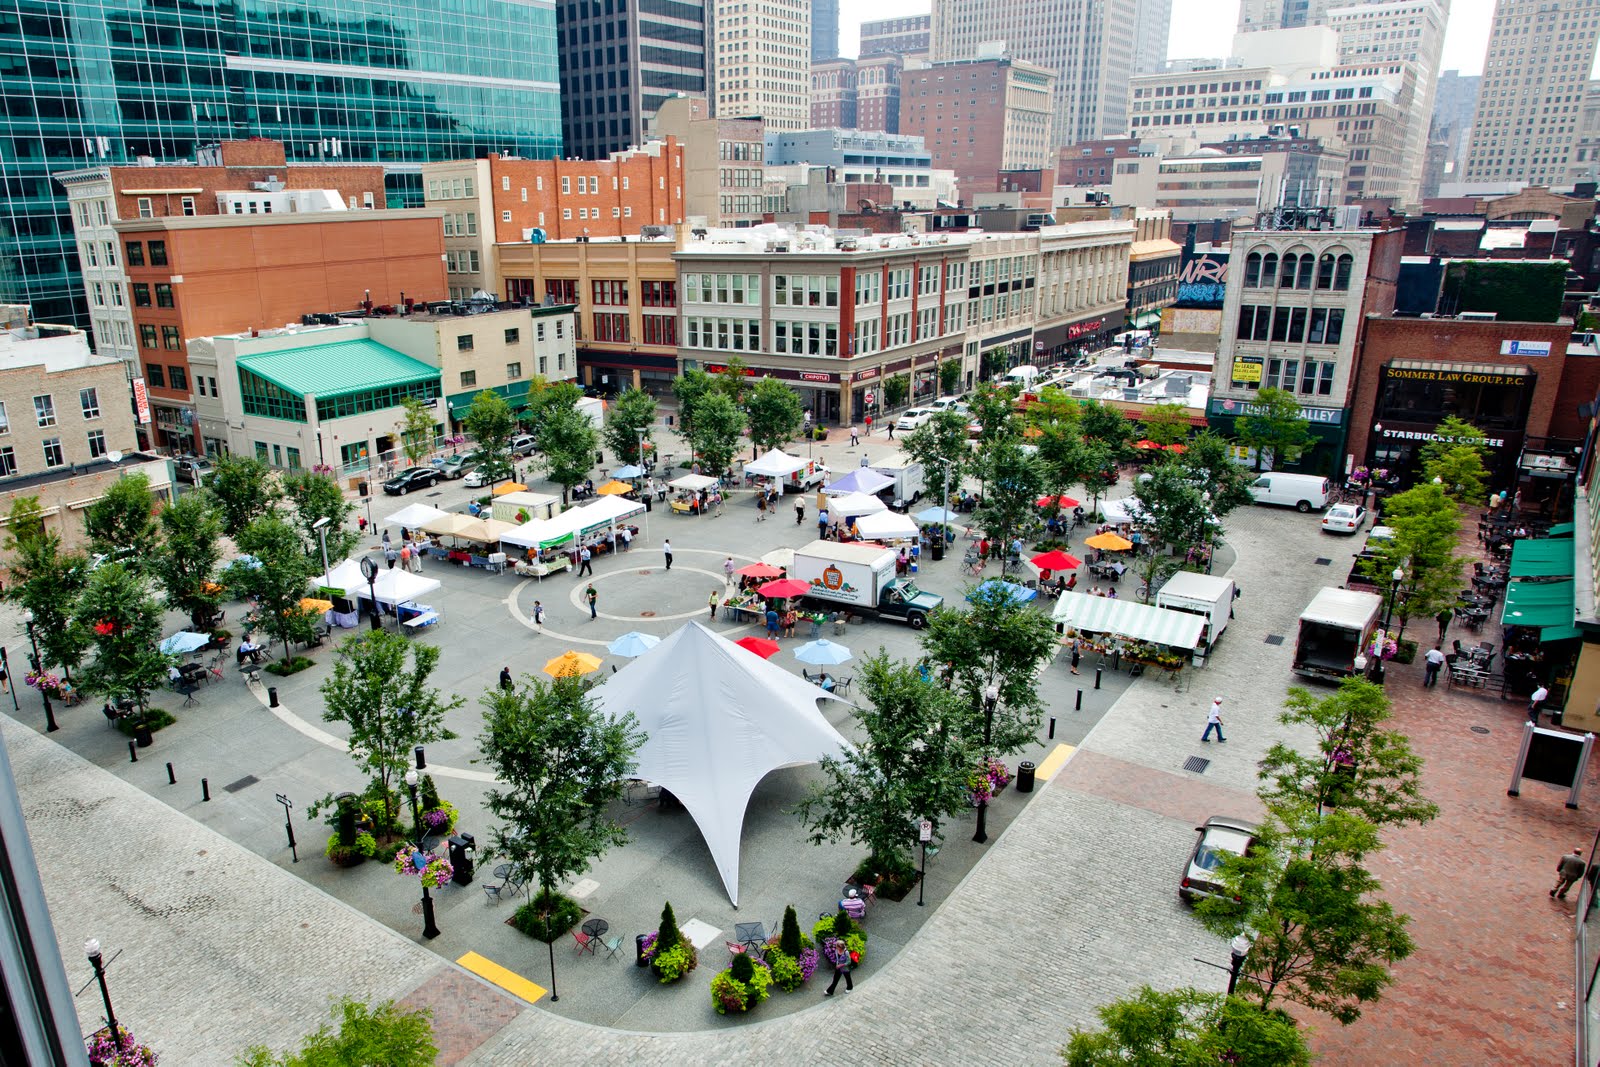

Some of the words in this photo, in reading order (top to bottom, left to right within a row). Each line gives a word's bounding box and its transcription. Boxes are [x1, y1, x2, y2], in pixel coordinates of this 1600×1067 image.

[1387, 368, 1435, 380] SOMMER
[1438, 371, 1461, 381] LAW
[1506, 377, 1525, 386] P.C.
[135, 381, 145, 413] CAMERA
[1383, 429, 1454, 443] STARBUCKS
